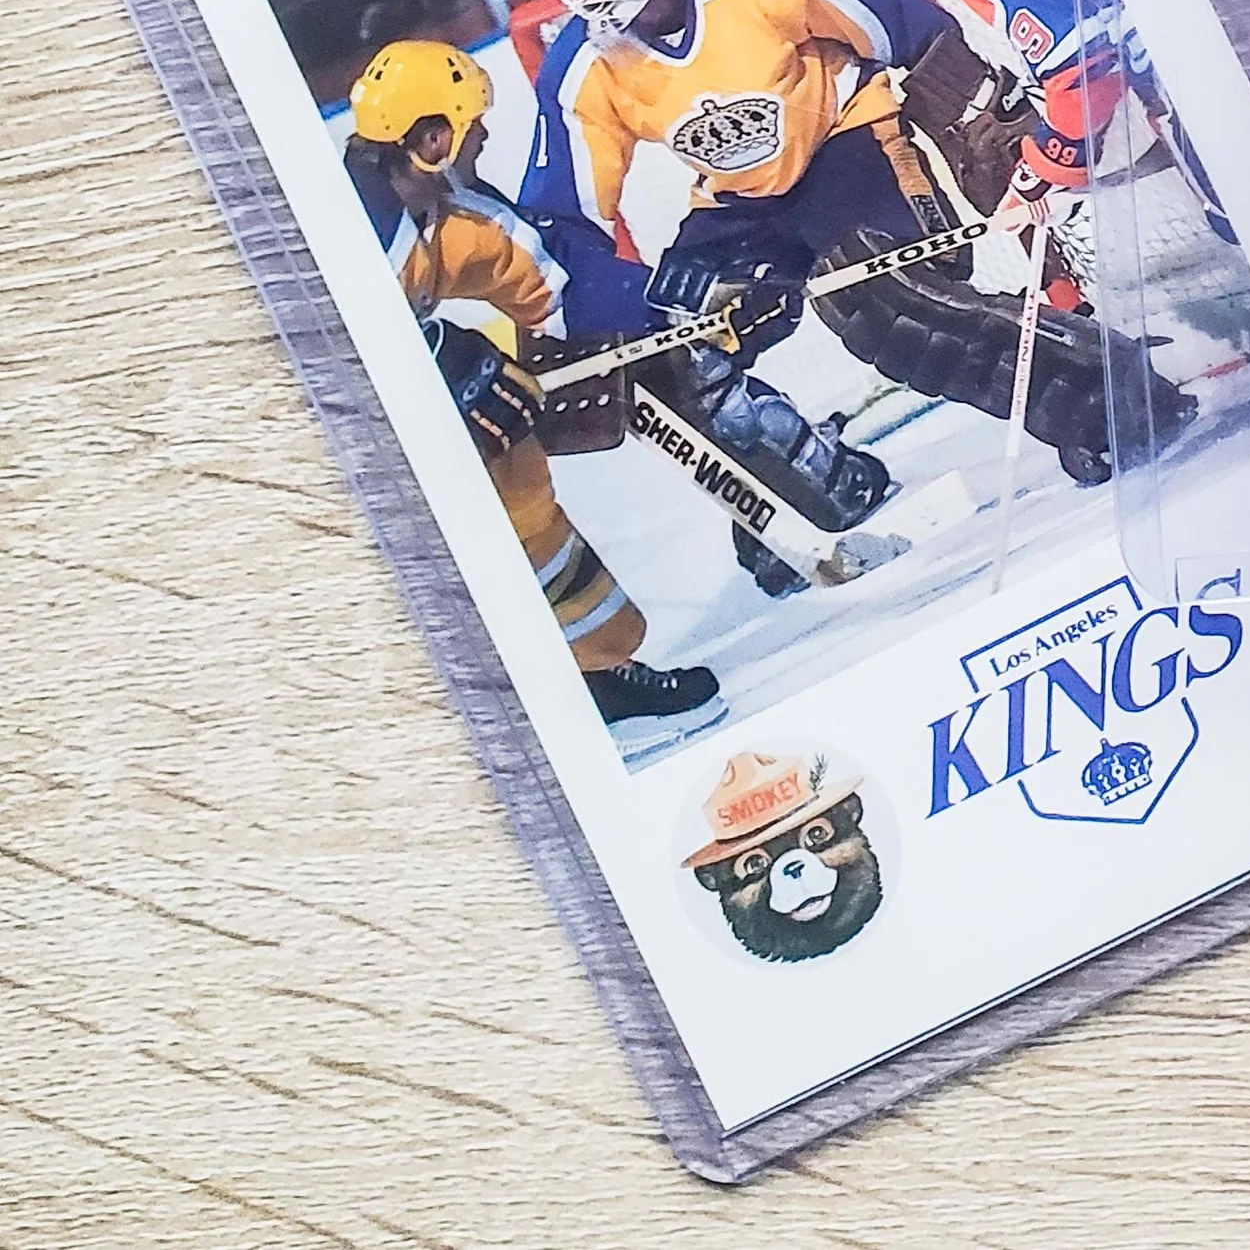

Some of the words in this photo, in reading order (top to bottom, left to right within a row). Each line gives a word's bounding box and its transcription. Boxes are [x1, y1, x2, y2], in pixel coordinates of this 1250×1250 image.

[1045, 138, 1077, 165] 99
[866, 223, 988, 273] KOHO
[630, 401, 777, 535] SHER-WOOD
[990, 645, 1031, 676] Los
[1035, 604, 1118, 657] Angeles
[925, 569, 1243, 819] KINGS
[717, 773, 800, 827] SMOKEY
